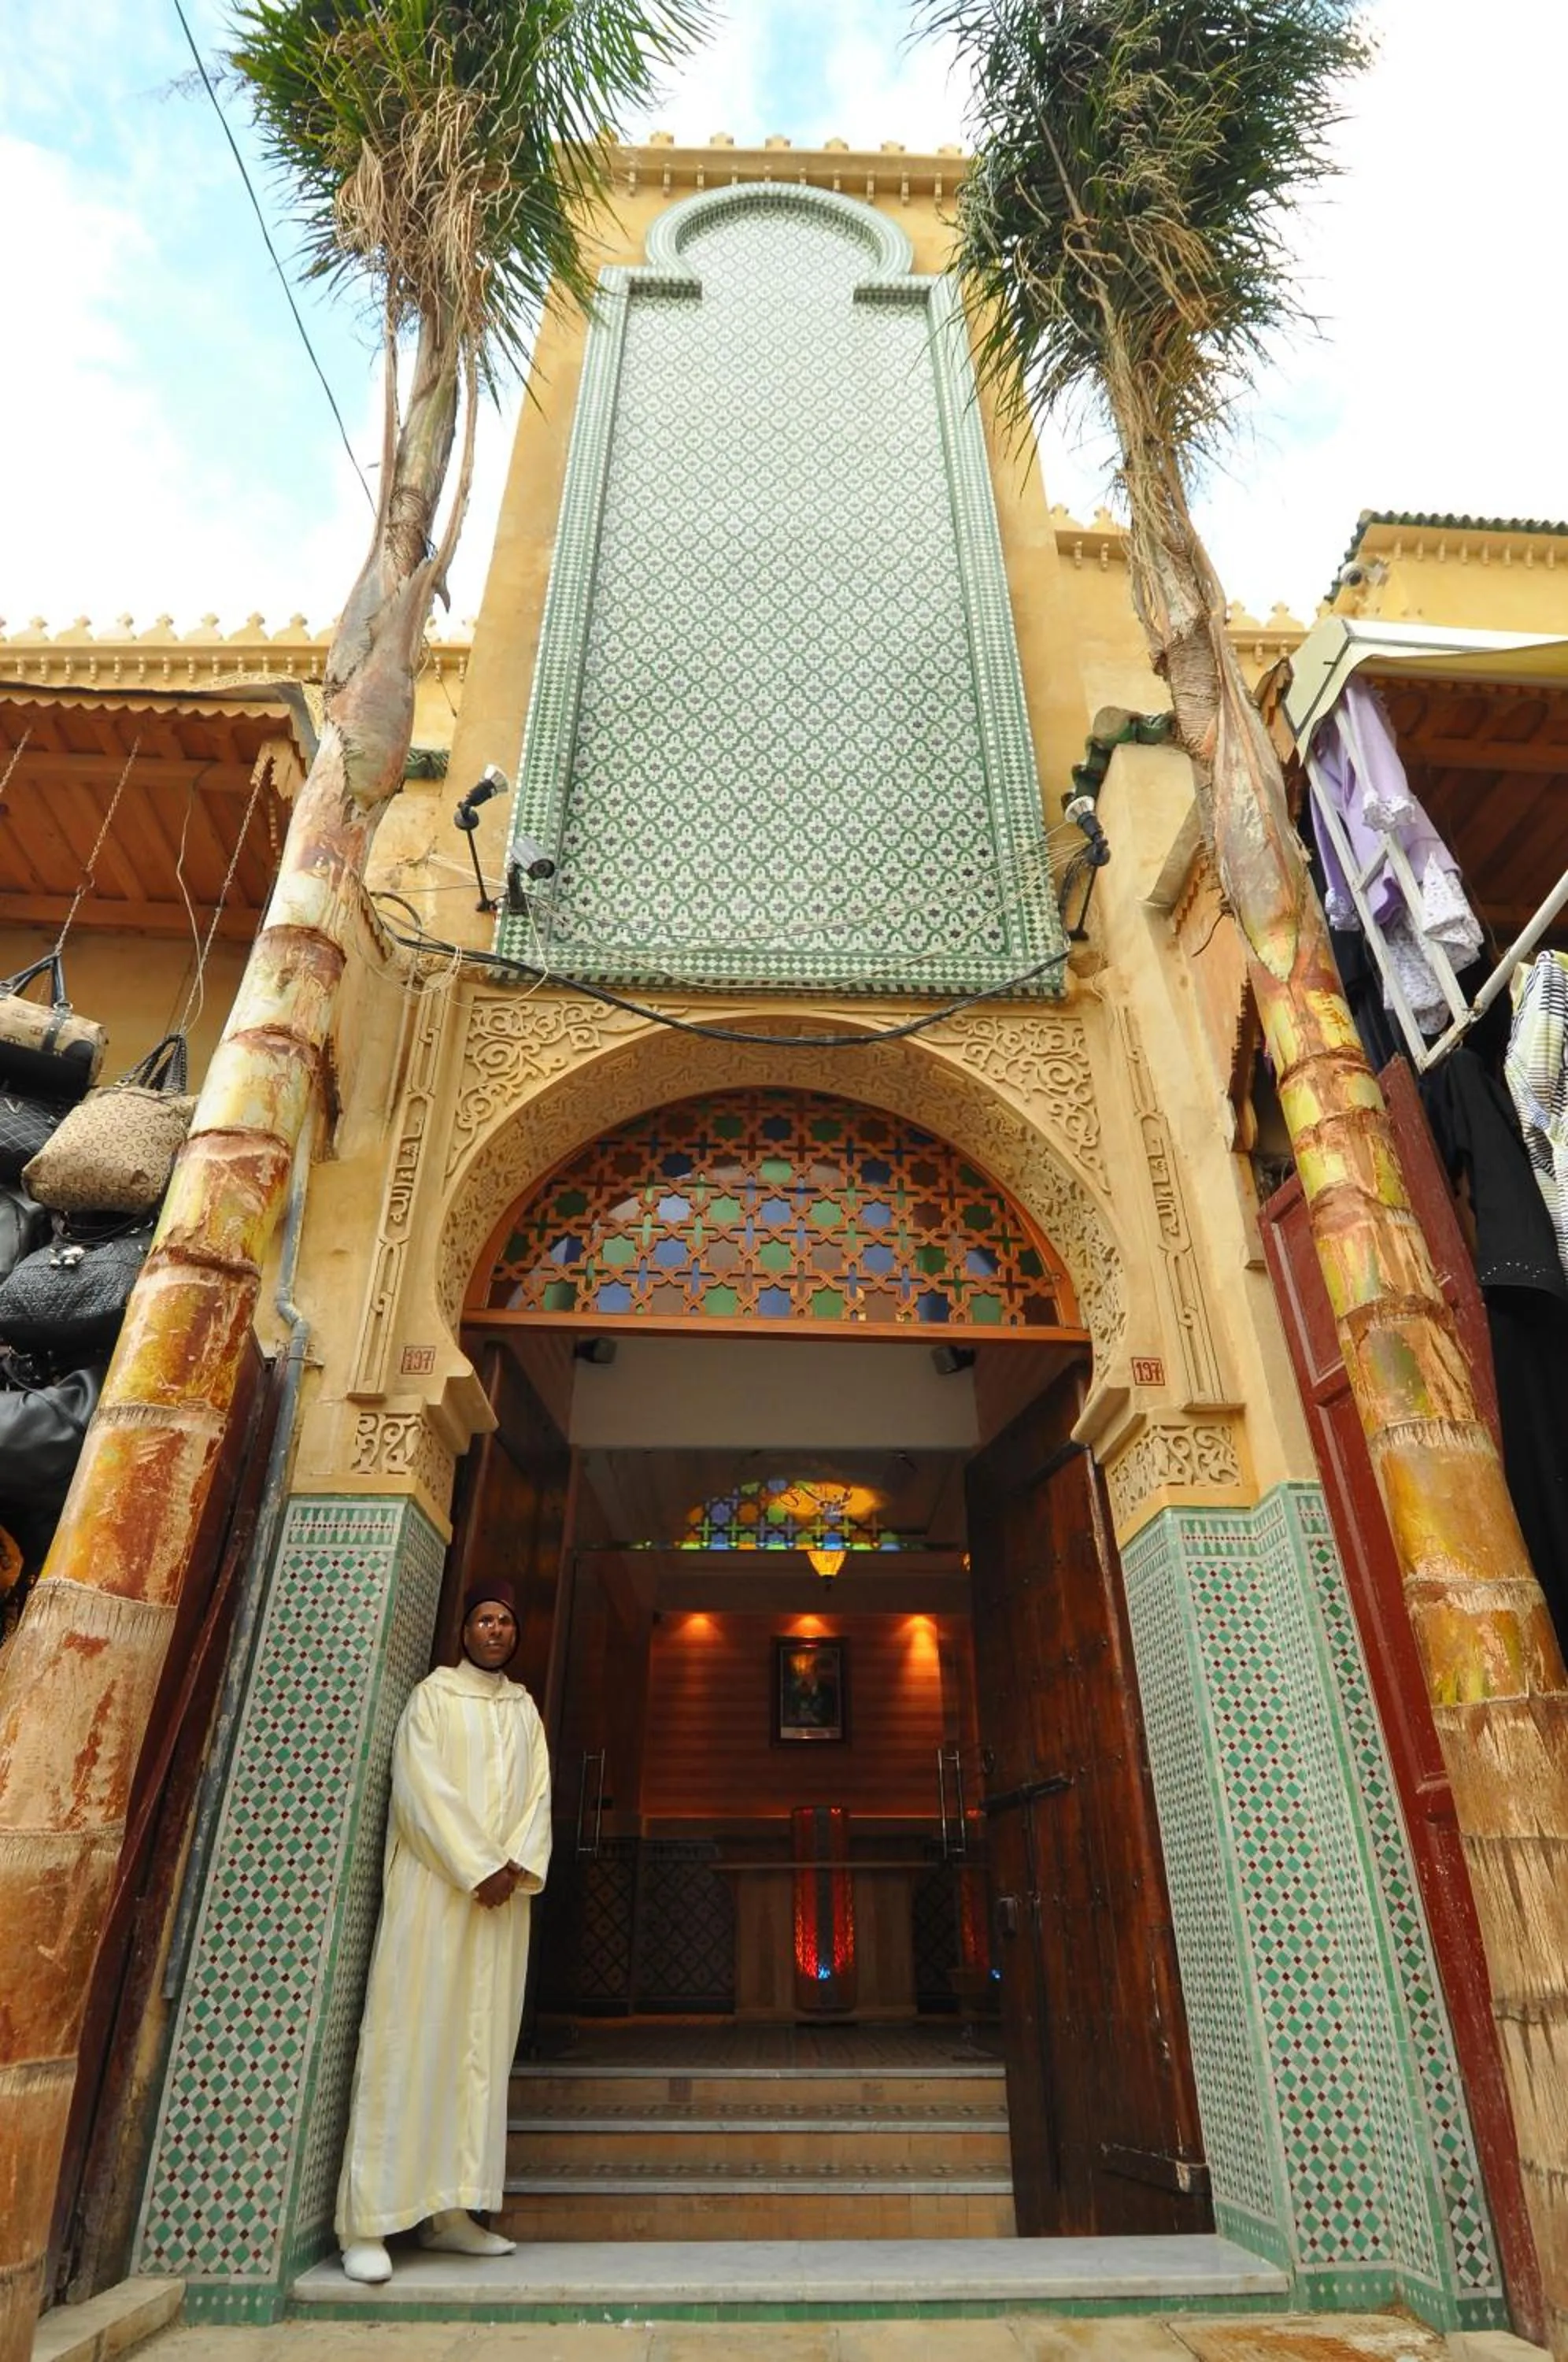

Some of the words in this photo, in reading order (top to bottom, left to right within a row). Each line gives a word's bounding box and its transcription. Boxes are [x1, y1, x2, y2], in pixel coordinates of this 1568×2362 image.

[390, 1181, 412, 1223] الله
[405, 1349, 432, 1370] 197
[1136, 1361, 1160, 1381] 197
